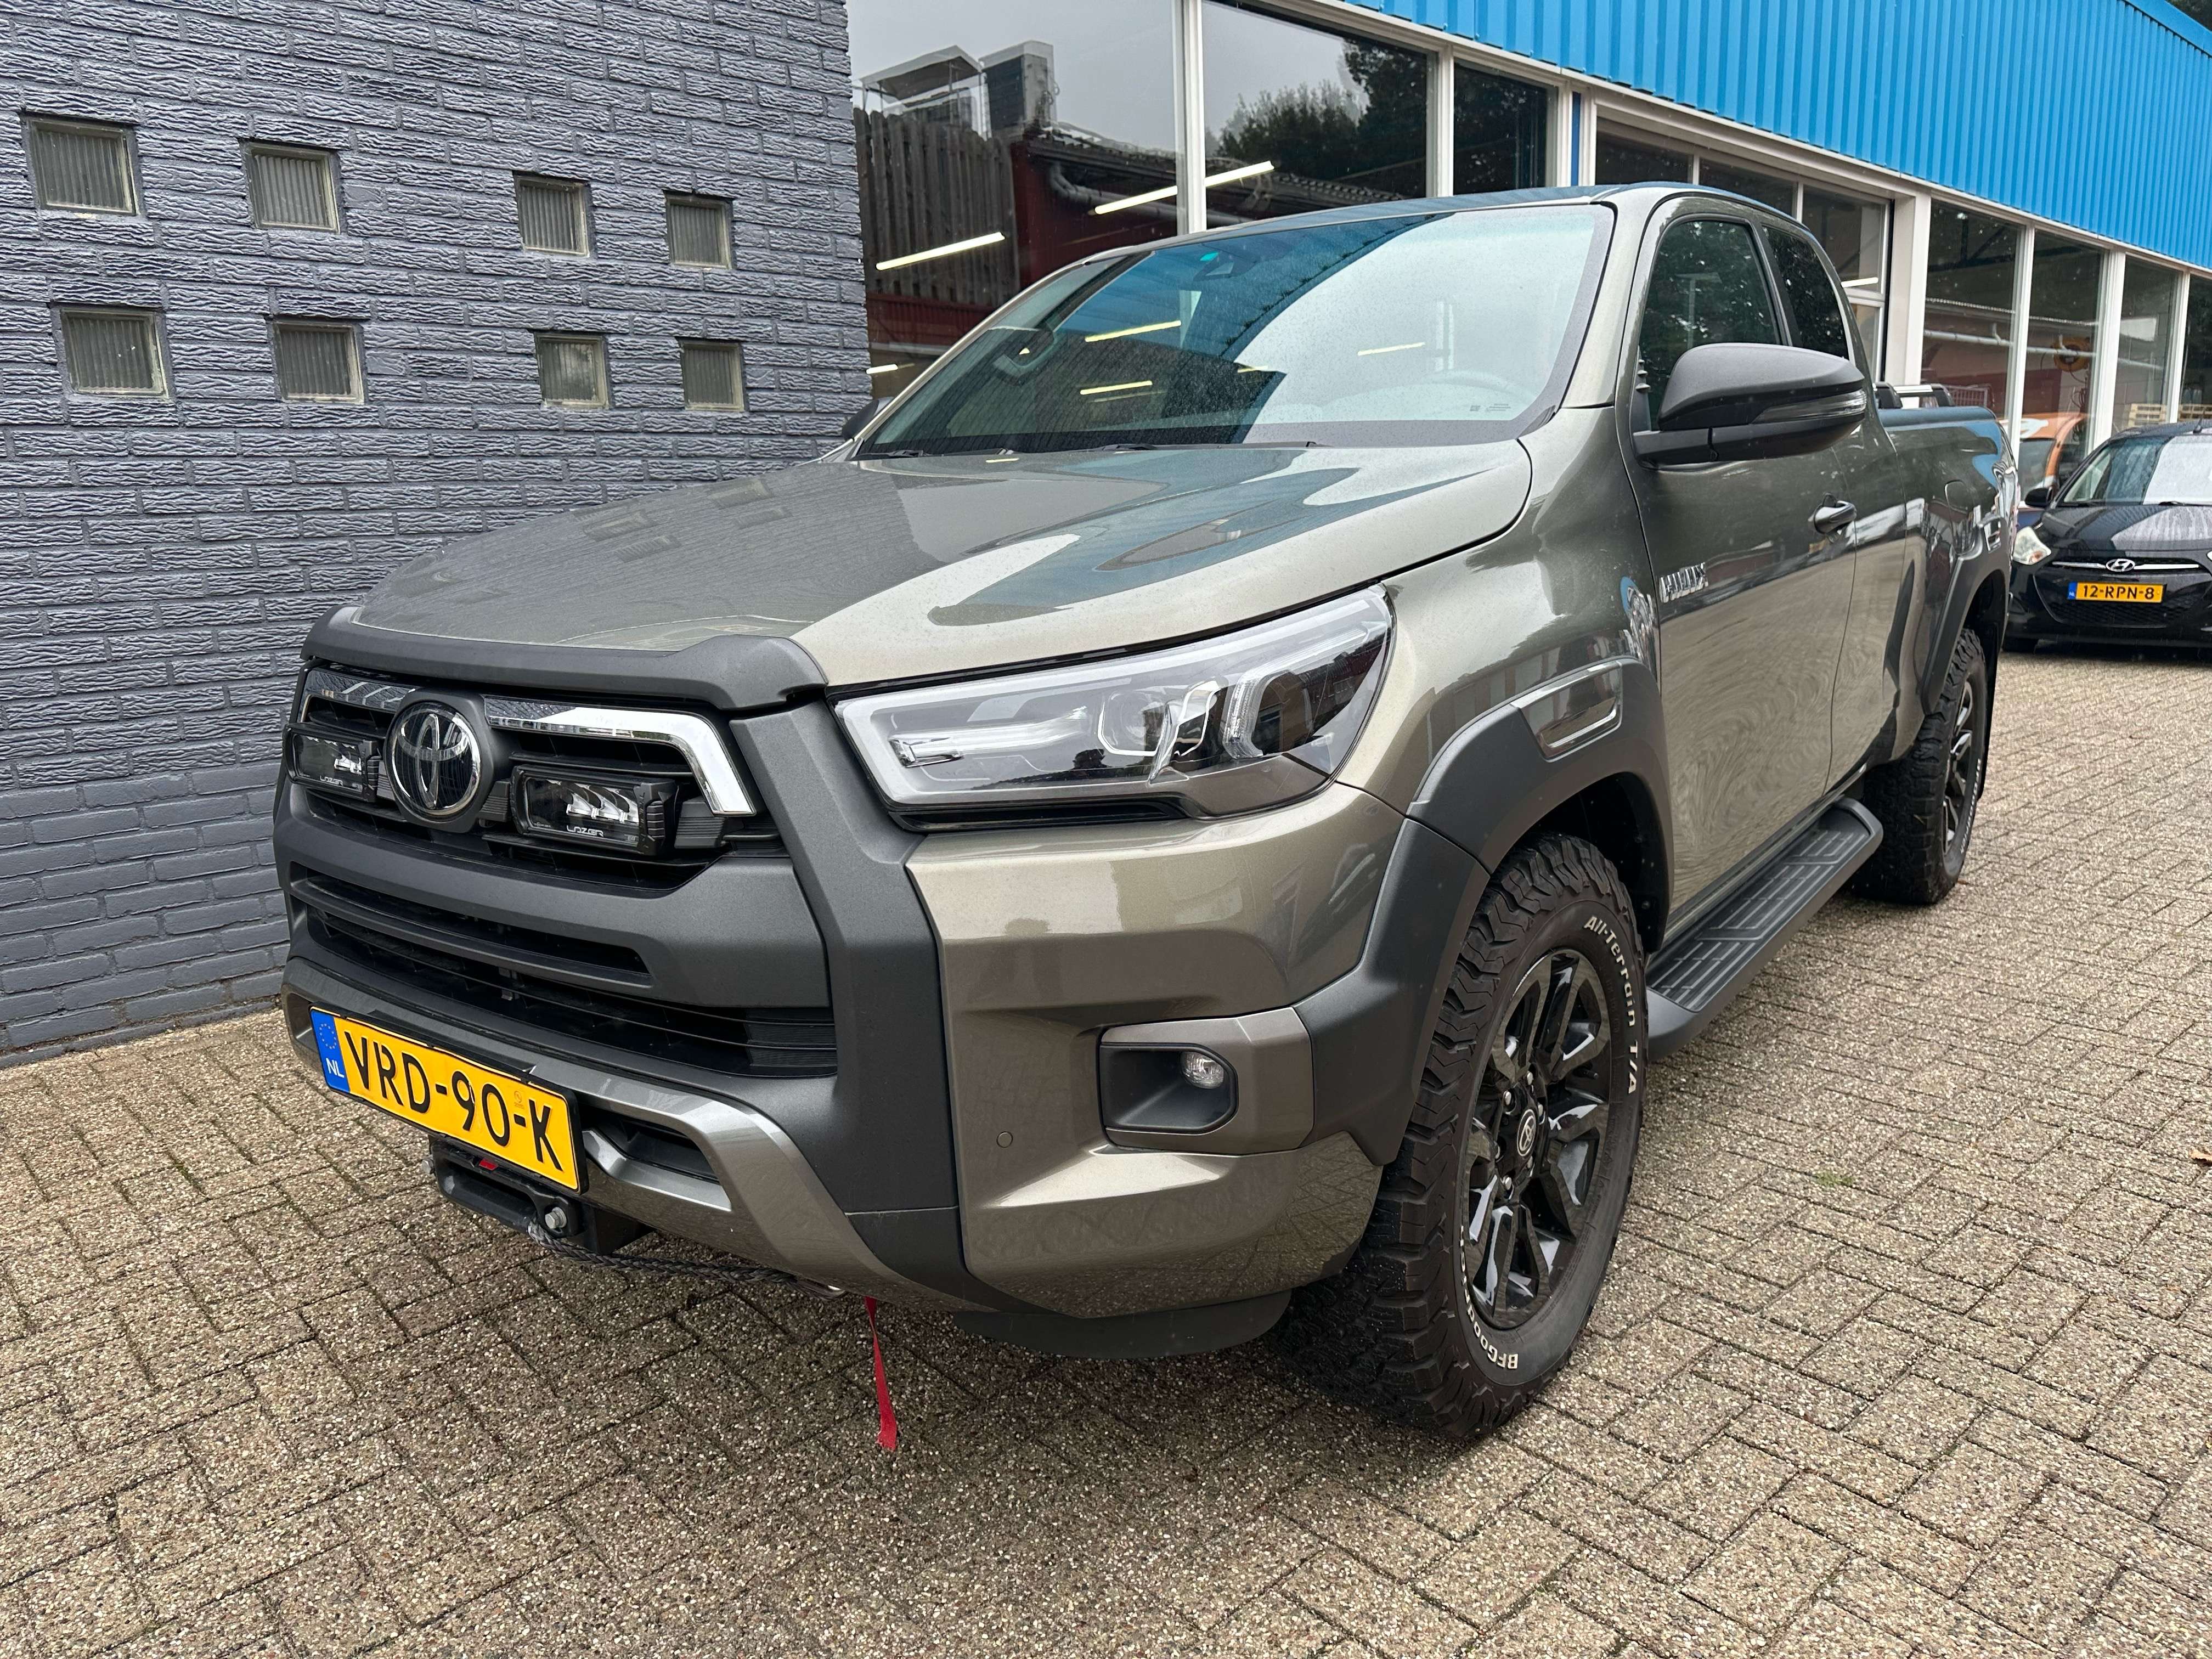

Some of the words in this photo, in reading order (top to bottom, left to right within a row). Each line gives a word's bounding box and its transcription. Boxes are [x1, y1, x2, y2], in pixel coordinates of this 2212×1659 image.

[2084, 585, 2154, 600] 12-RPN-8
[1583, 915, 1635, 1027] All-Terrain
[1628, 1040, 1638, 1094] T/A
[326, 1058, 345, 1079] NL
[345, 1031, 563, 1172] VRD-90-K
